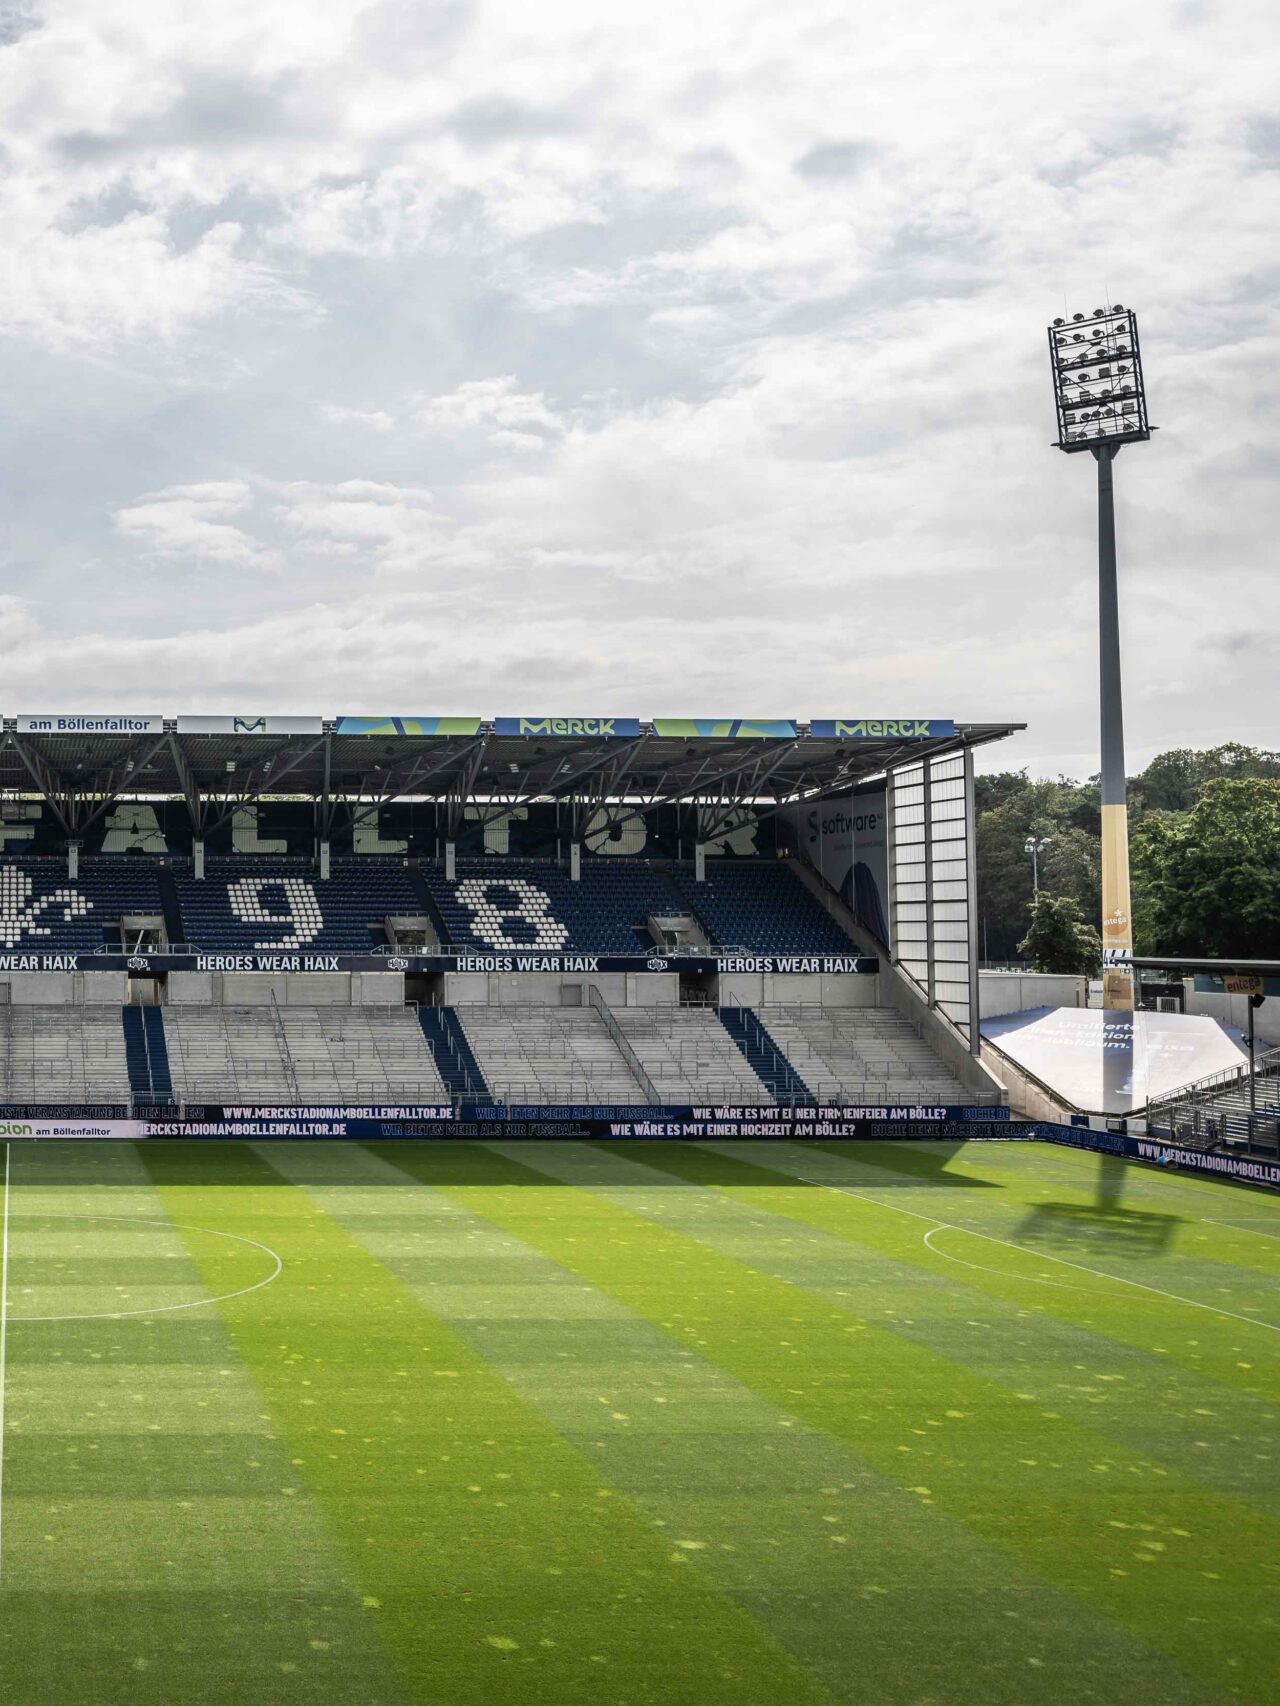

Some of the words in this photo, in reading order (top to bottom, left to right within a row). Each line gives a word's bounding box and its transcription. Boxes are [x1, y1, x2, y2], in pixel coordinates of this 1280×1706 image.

[29, 721, 51, 730] am
[58, 718, 150, 730] Böllenfalltor
[822, 812, 877, 834] software
[43, 956, 78, 970] HAIX
[196, 957, 253, 970] HEROES
[257, 957, 303, 970] WEAR
[306, 957, 339, 970] HAIX
[456, 957, 512, 971] HEROES
[516, 957, 560, 971] WEAR
[563, 957, 599, 971] HAIX
[717, 958, 773, 972] HEROES
[777, 958, 820, 972] WEAR
[823, 958, 859, 972] HAIX
[1227, 977, 1261, 992] entega
[223, 1107, 453, 1119] WWW.MERCKSTADIONAMBOELLENFALLTOR.DE
[692, 1108, 711, 1119] WIE
[714, 1106, 742, 1119] WÄRE
[745, 1108, 757, 1119] ES
[760, 1108, 779, 1119] MIT
[889, 1108, 907, 1119] AM
[909, 1106, 946, 1119] BÖLLE?
[36, 1128, 51, 1136] am
[53, 1127, 111, 1136] Böllenfalltor
[610, 1123, 631, 1136] WIE
[634, 1121, 664, 1136] WÄRE
[666, 1123, 680, 1136] ES
[682, 1123, 704, 1136] MIT
[706, 1123, 738, 1136] EINER
[741, 1123, 792, 1136] HOCHZEIT
[794, 1123, 814, 1136] AM
[815, 1121, 855, 1136] BÖLLE?
